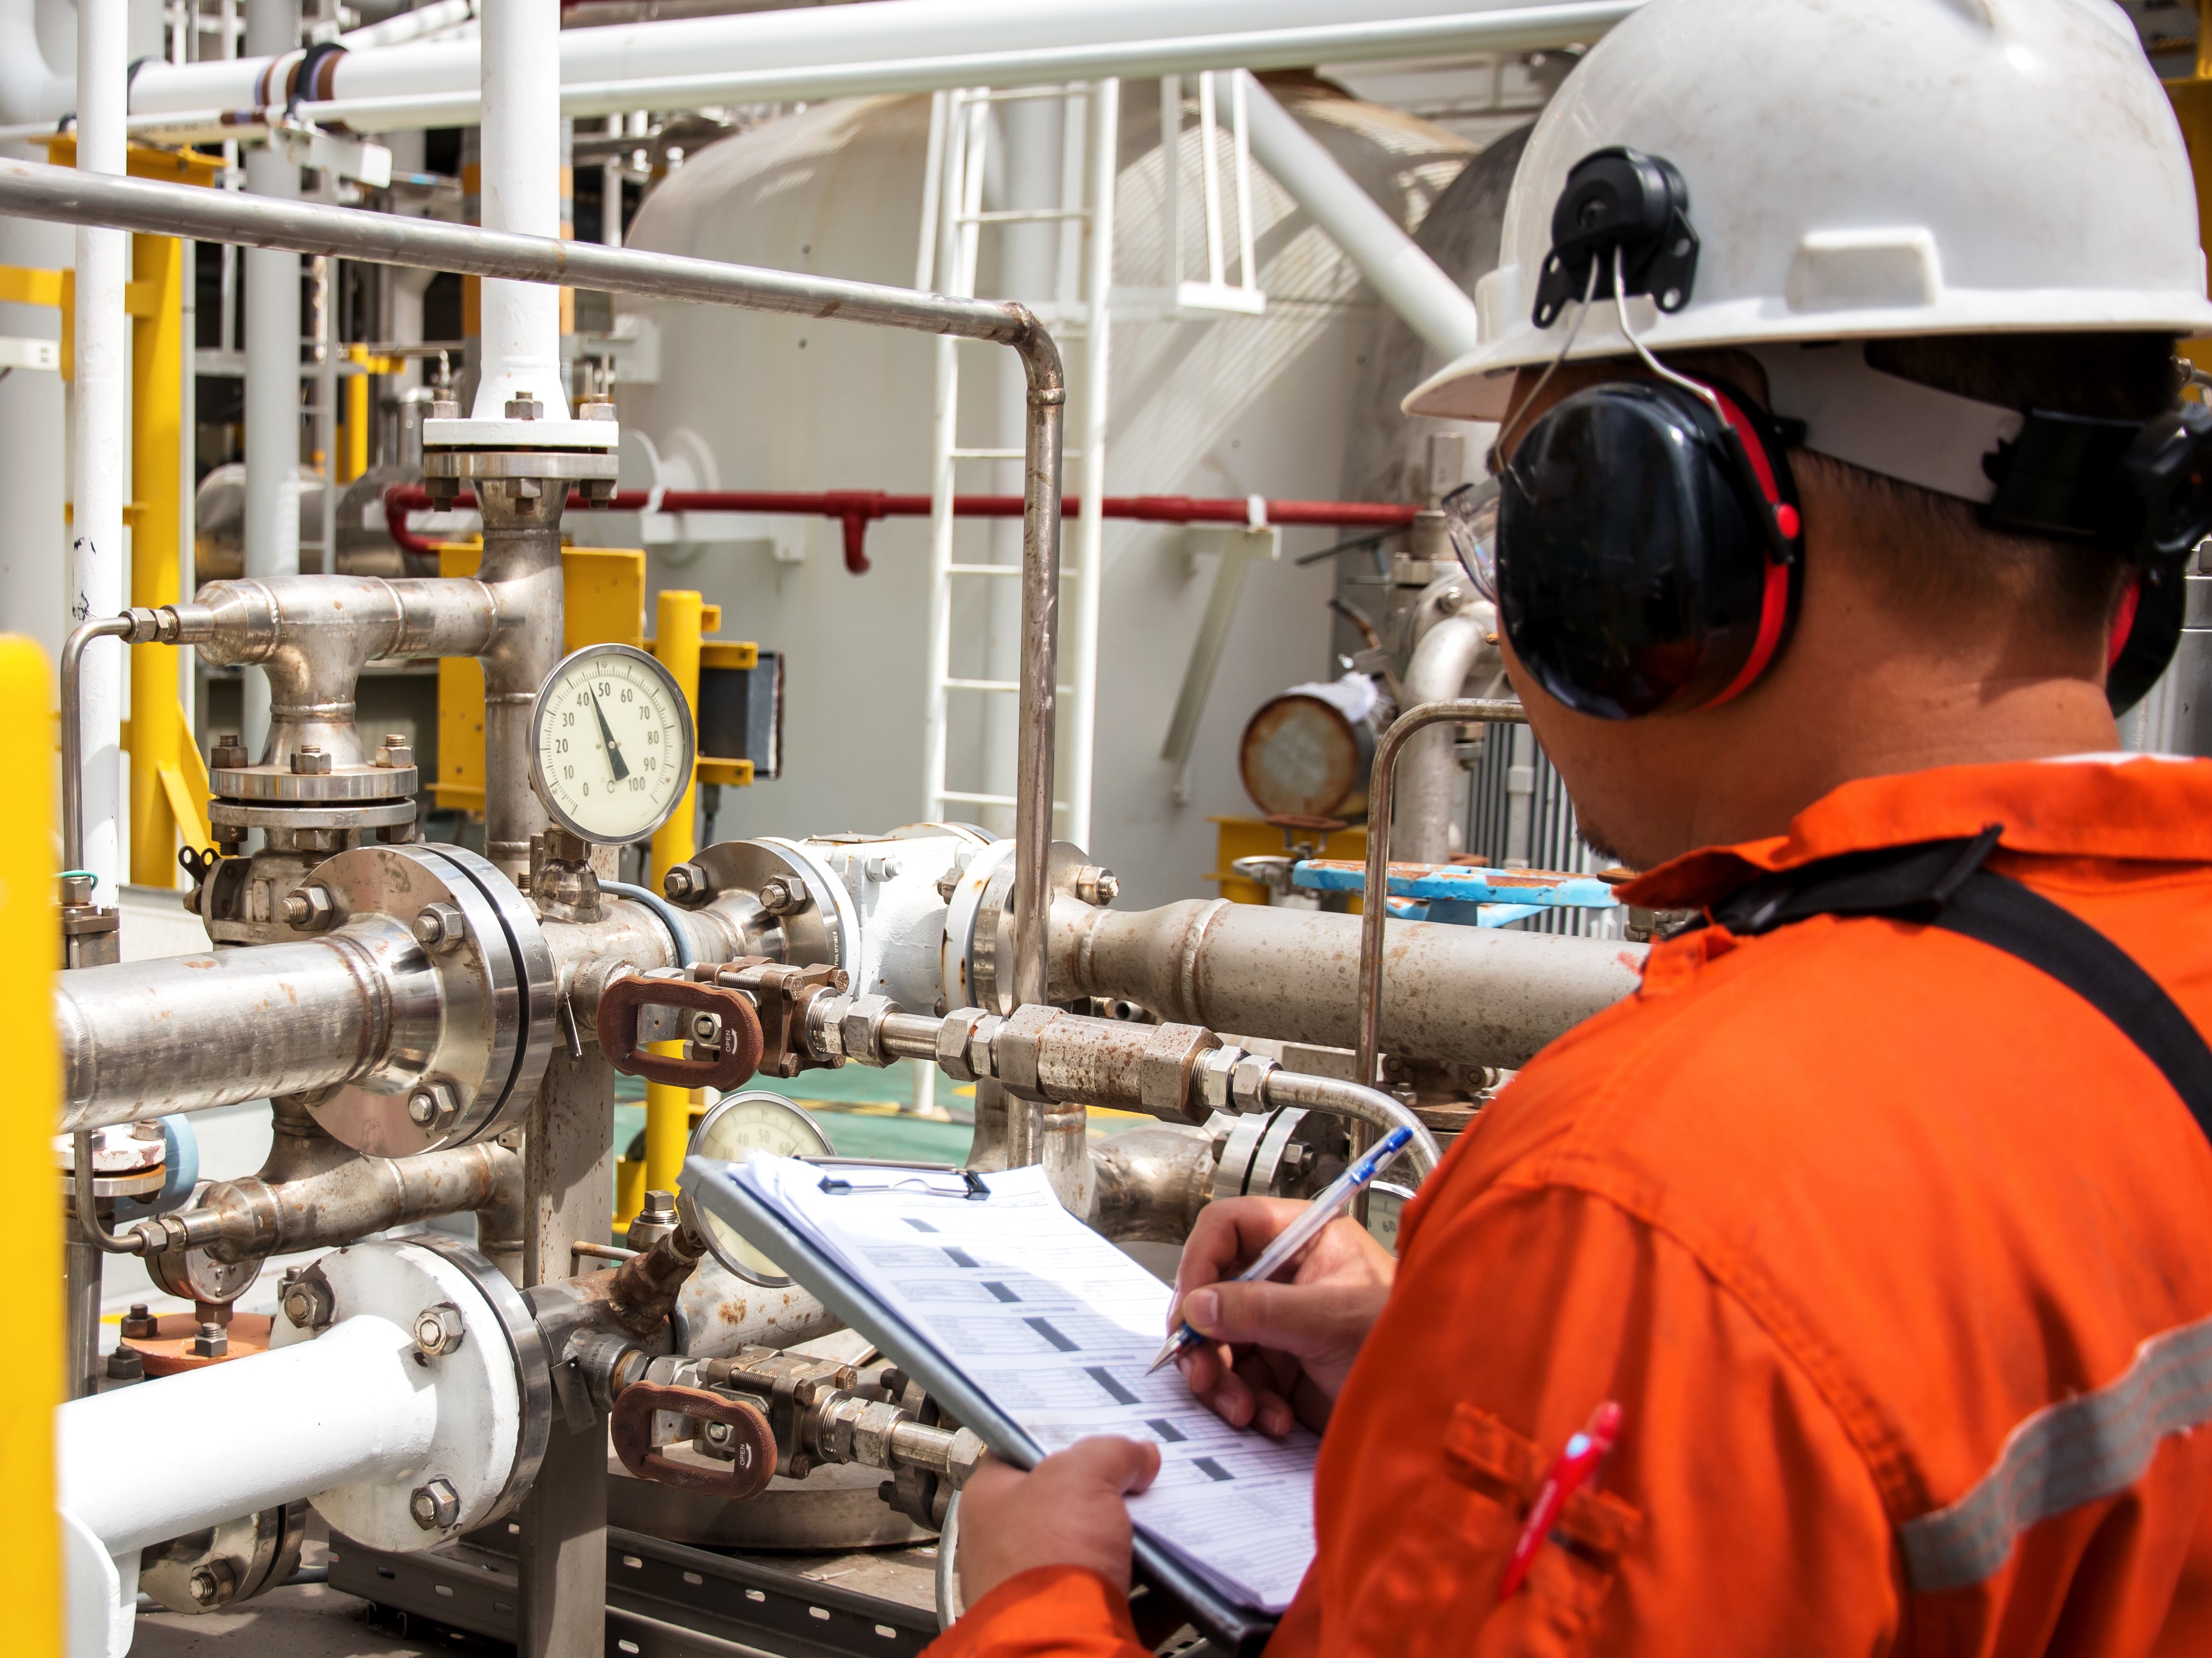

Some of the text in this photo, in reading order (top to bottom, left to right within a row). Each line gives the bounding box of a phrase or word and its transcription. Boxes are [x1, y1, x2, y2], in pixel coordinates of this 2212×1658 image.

[599, 682, 611, 696] 50
[620, 688, 633, 703] 60
[577, 692, 589, 707] 40
[562, 712, 575, 726] 30
[639, 705, 650, 720] 70
[647, 730, 659, 745] 80
[555, 738, 568, 753] 20
[563, 764, 574, 780] 10
[643, 757, 656, 772] 90
[583, 782, 589, 797] 0
[628, 776, 646, 792] 100
[737, 1133, 749, 1146] 40
[758, 1129, 770, 1143] 50
[722, 1148, 733, 1160] 30
[779, 1141, 791, 1154] 60
